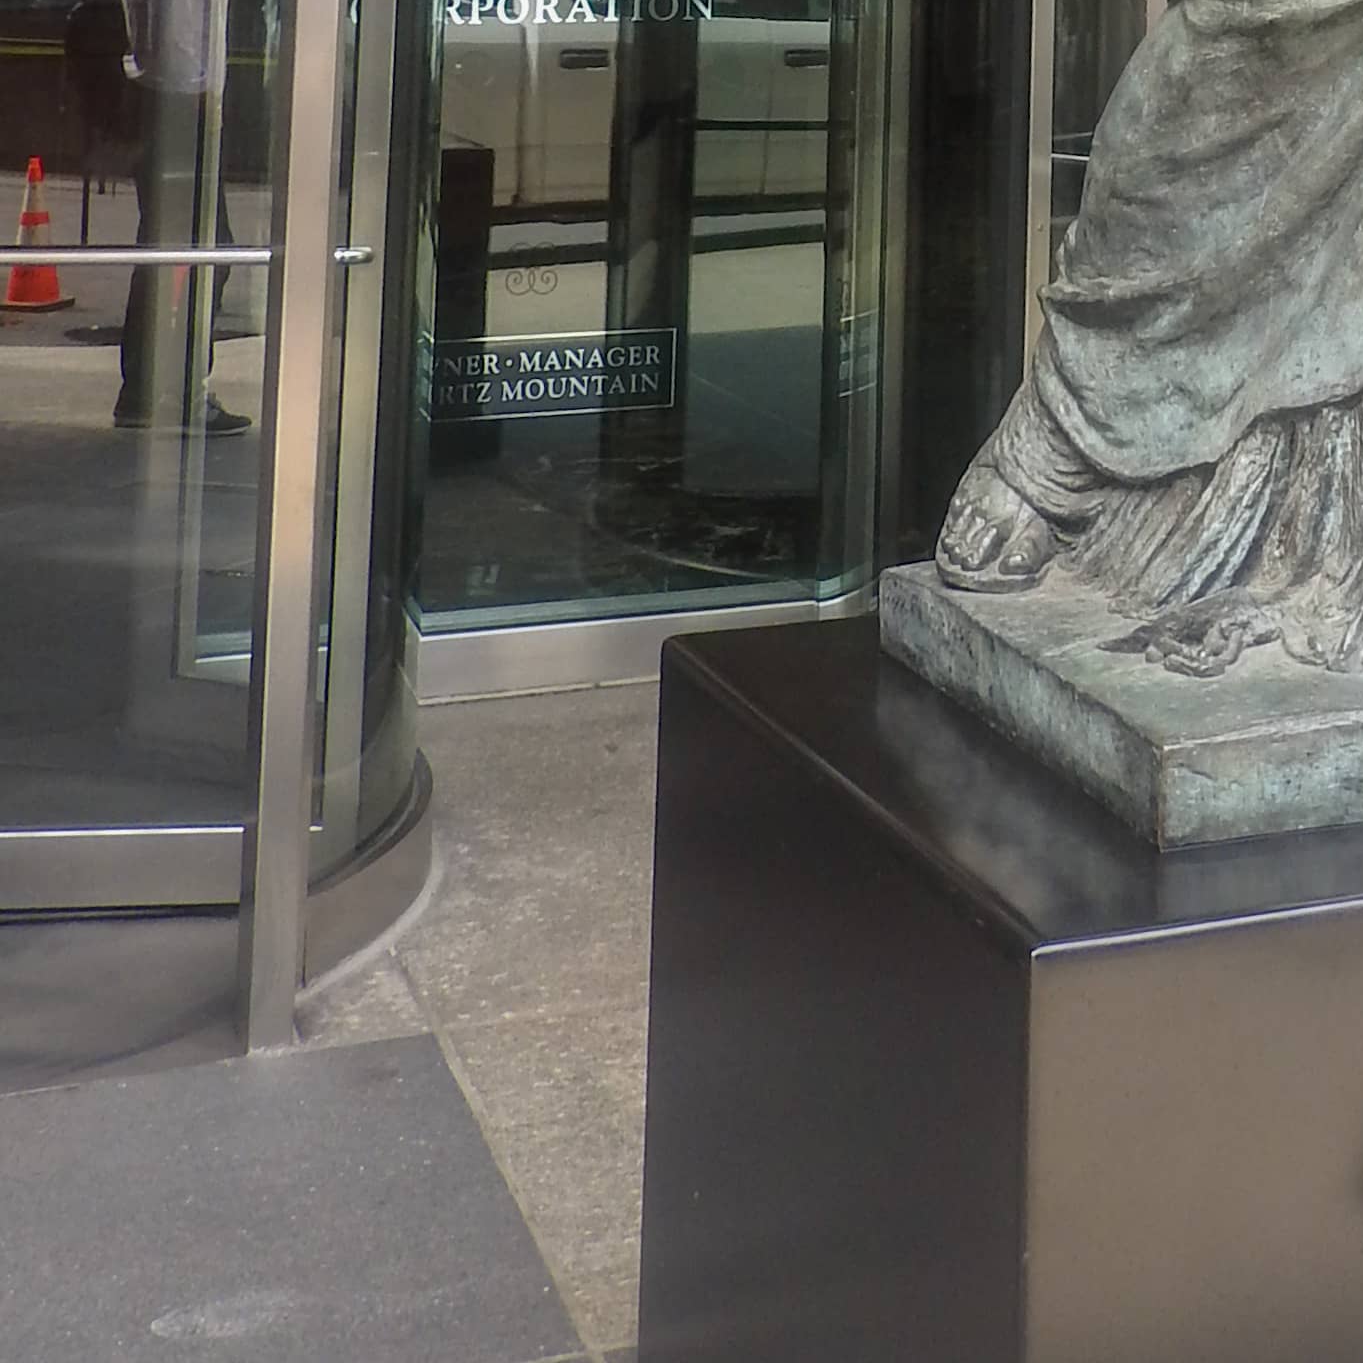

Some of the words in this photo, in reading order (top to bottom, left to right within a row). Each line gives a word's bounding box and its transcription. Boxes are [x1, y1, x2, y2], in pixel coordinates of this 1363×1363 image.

[435, 353, 500, 377] NER
[519, 345, 661, 373] MANAGER
[501, 373, 660, 403] MOUNTAIN
